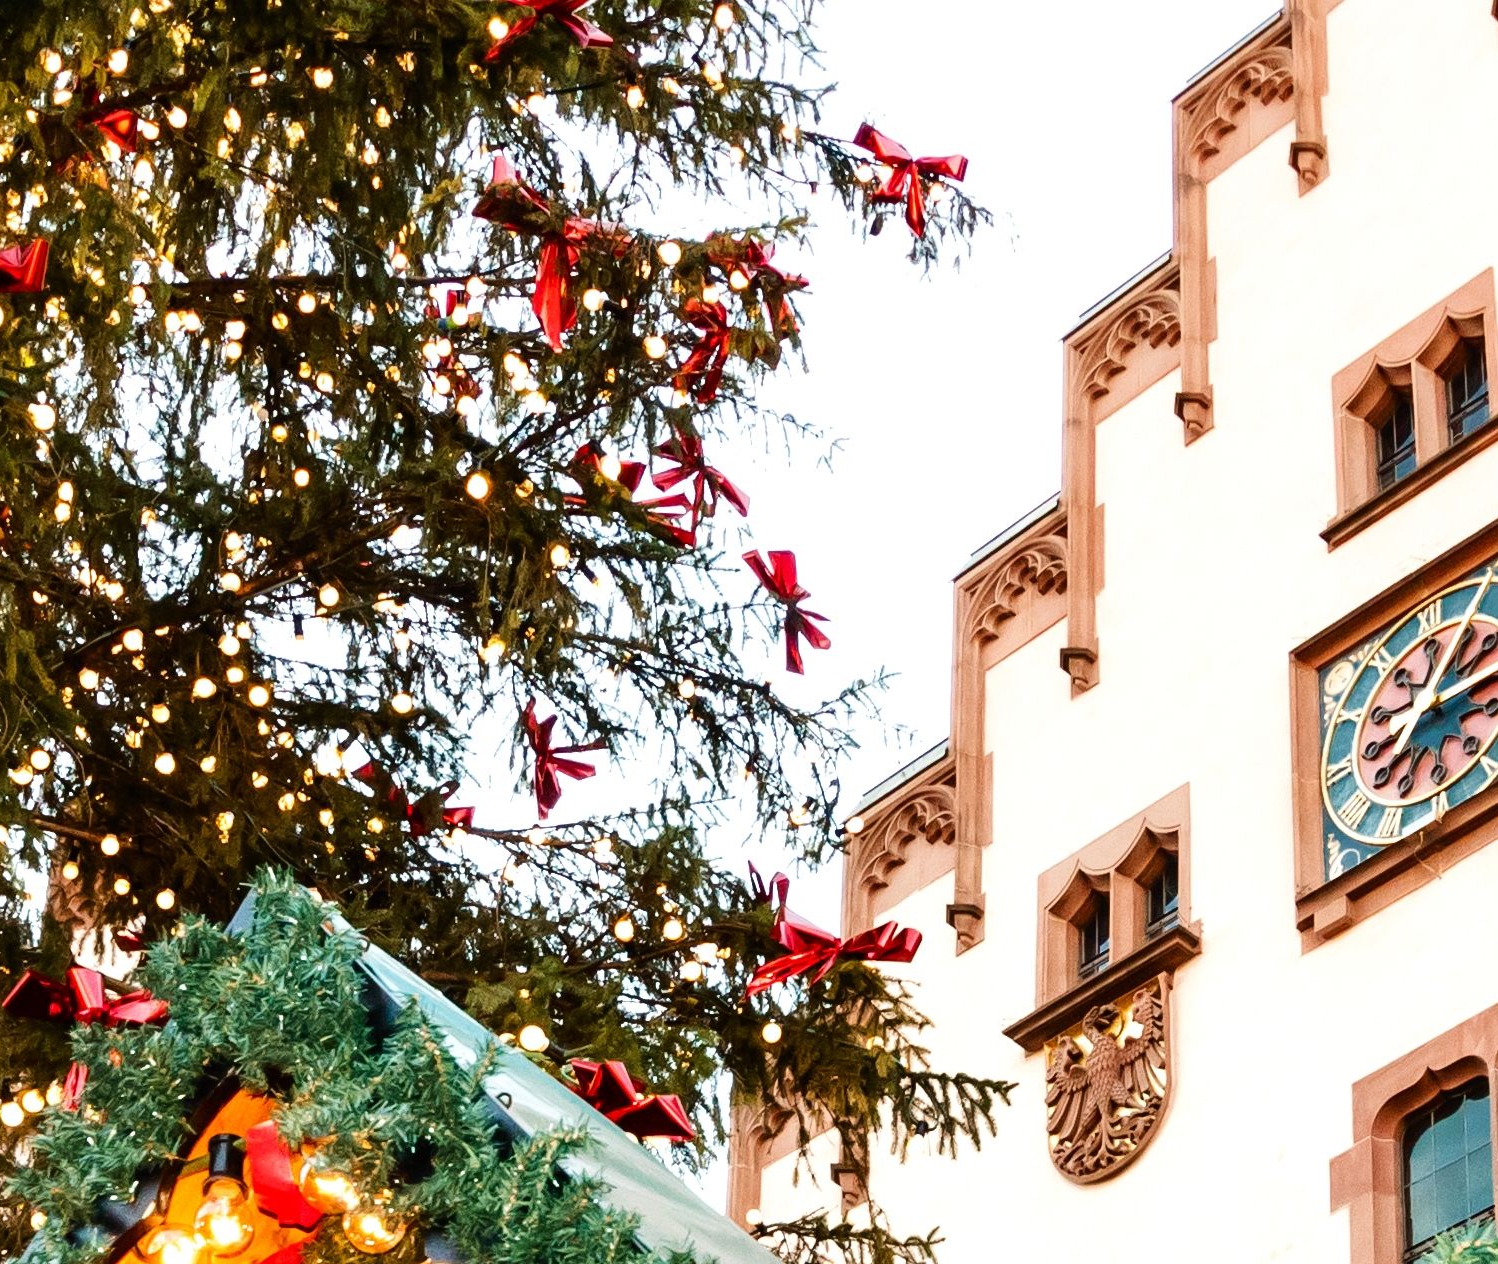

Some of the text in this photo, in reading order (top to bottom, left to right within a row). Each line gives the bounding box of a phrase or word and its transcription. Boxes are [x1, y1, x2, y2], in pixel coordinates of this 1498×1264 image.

[1417, 599, 1442, 635] XII
[1368, 646, 1394, 676] XI
[1336, 708, 1362, 724] X
